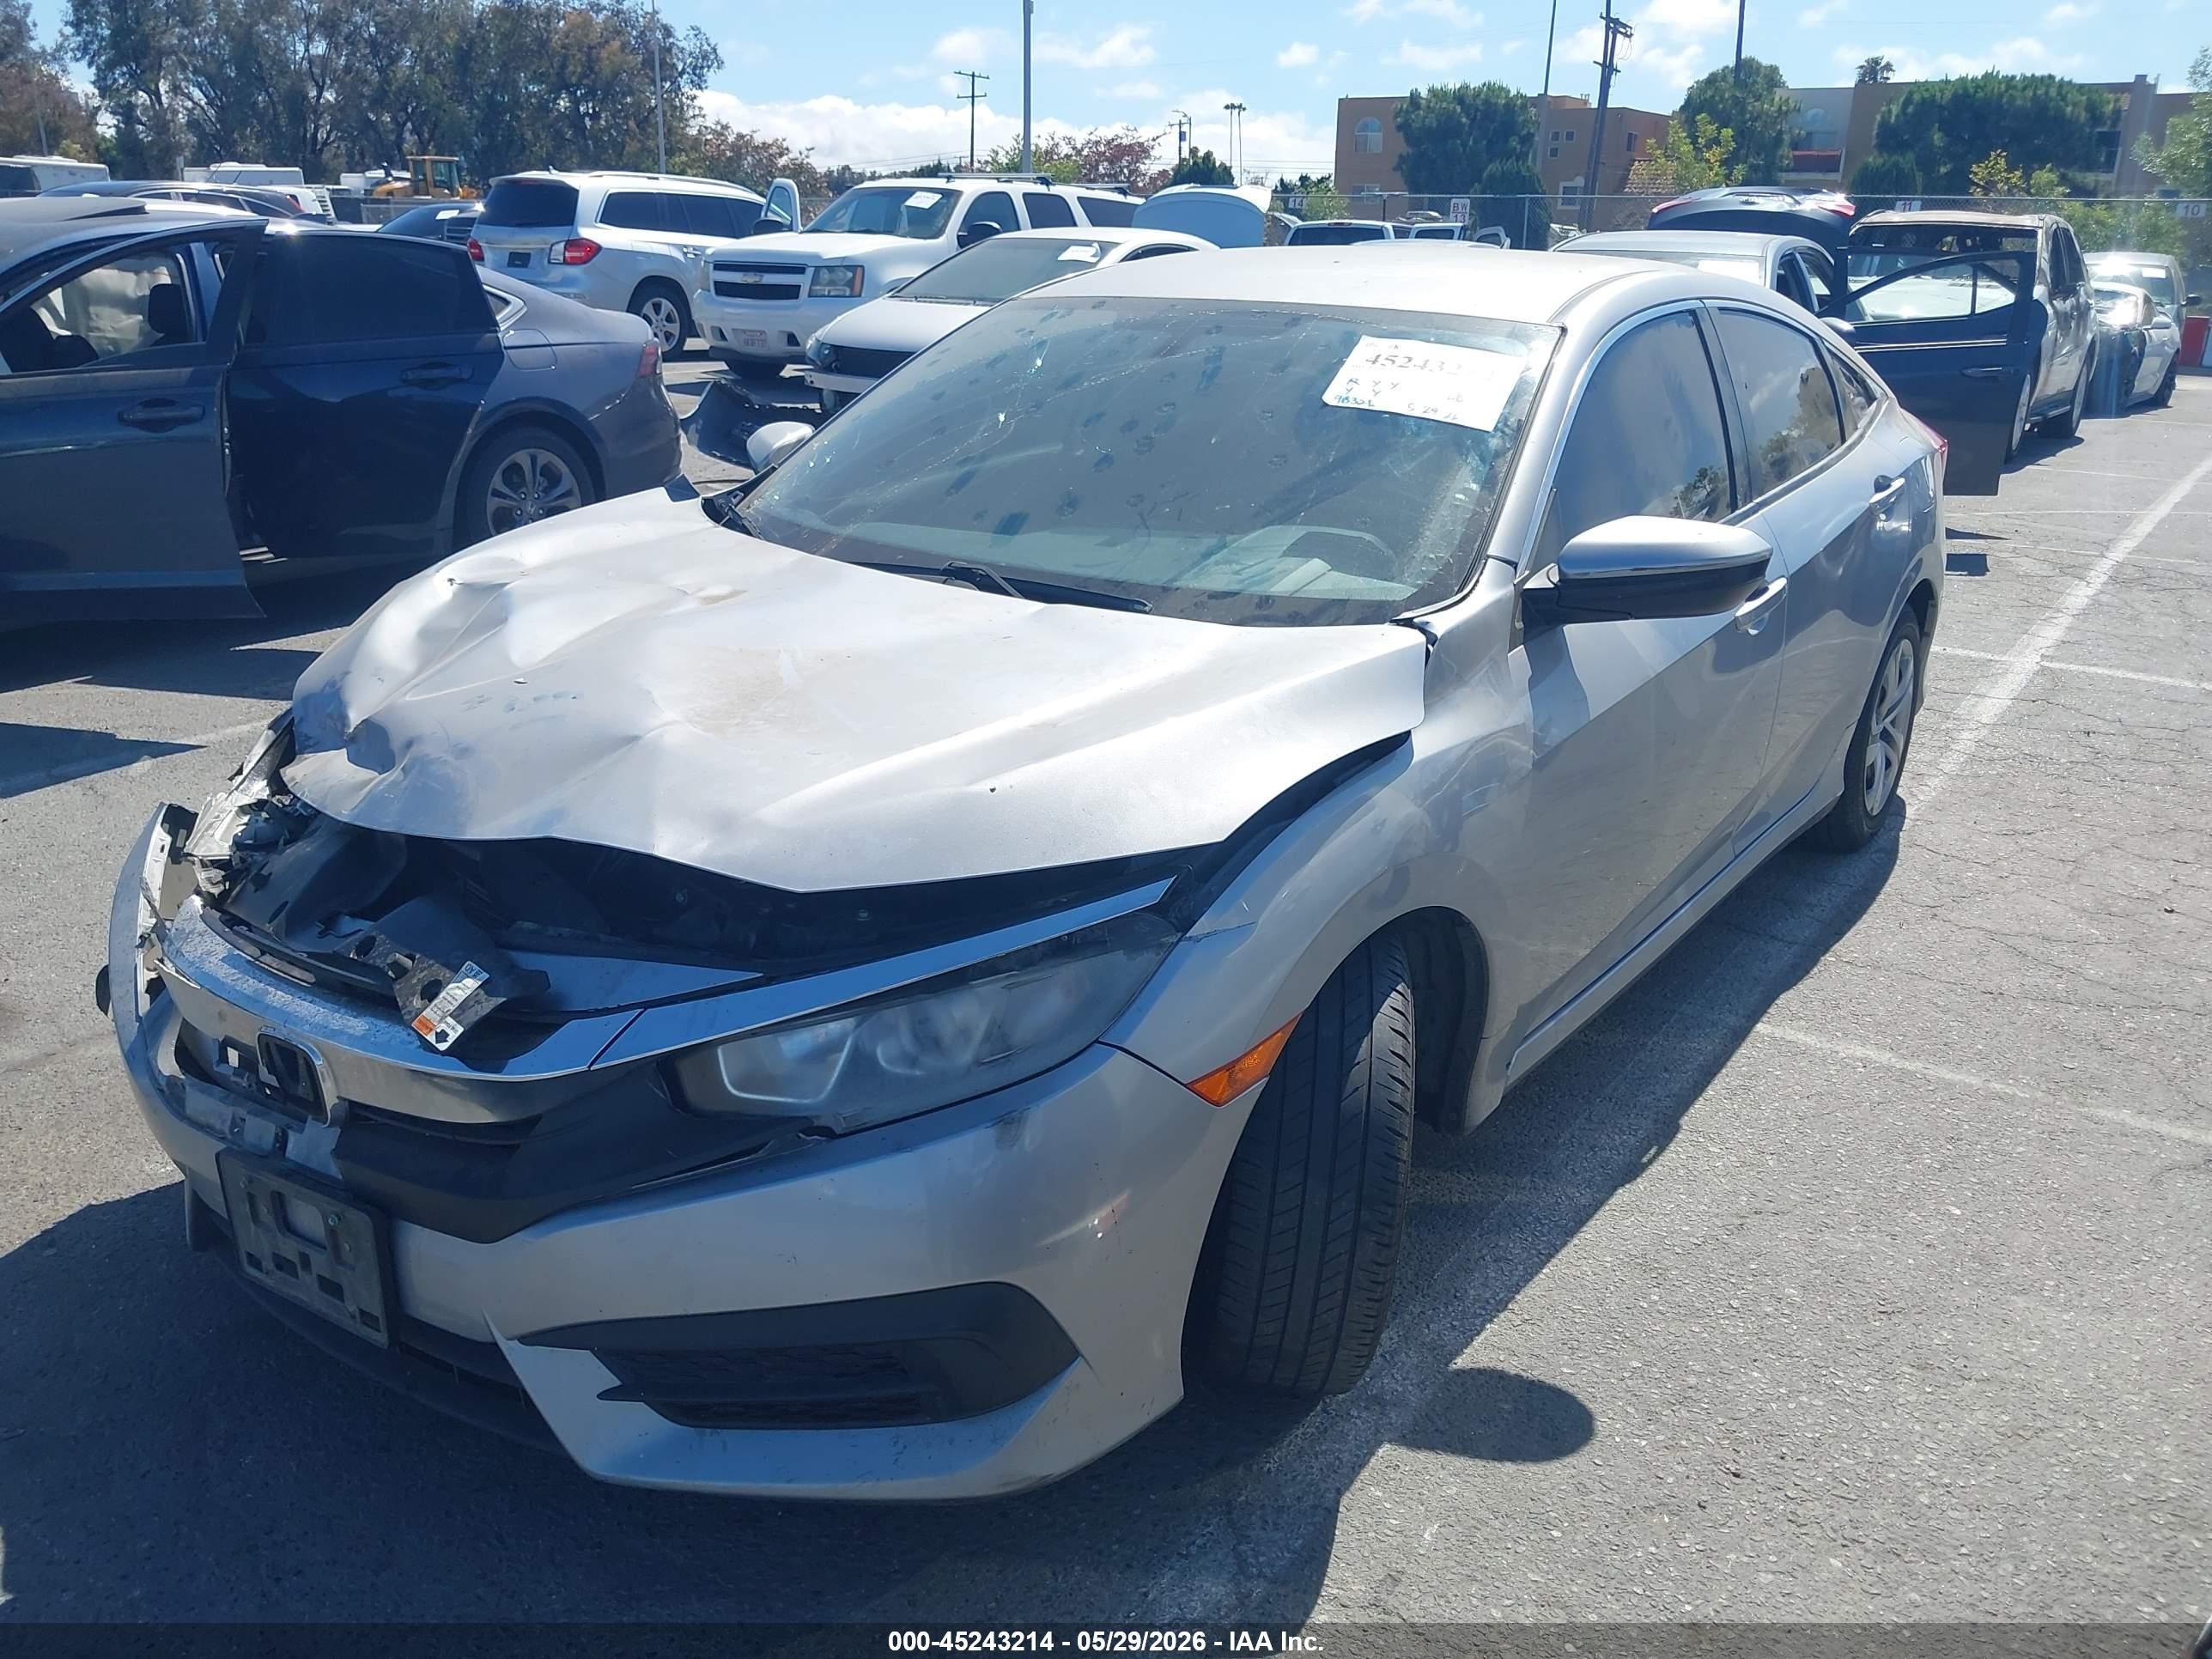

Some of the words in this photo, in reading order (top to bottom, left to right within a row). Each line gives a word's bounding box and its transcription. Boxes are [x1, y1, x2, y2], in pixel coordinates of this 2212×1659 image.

[1453, 202, 1468, 211] BW
[1901, 201, 1912, 213] 11
[2184, 204, 2200, 216] 10
[1453, 214, 1466, 223] 13
